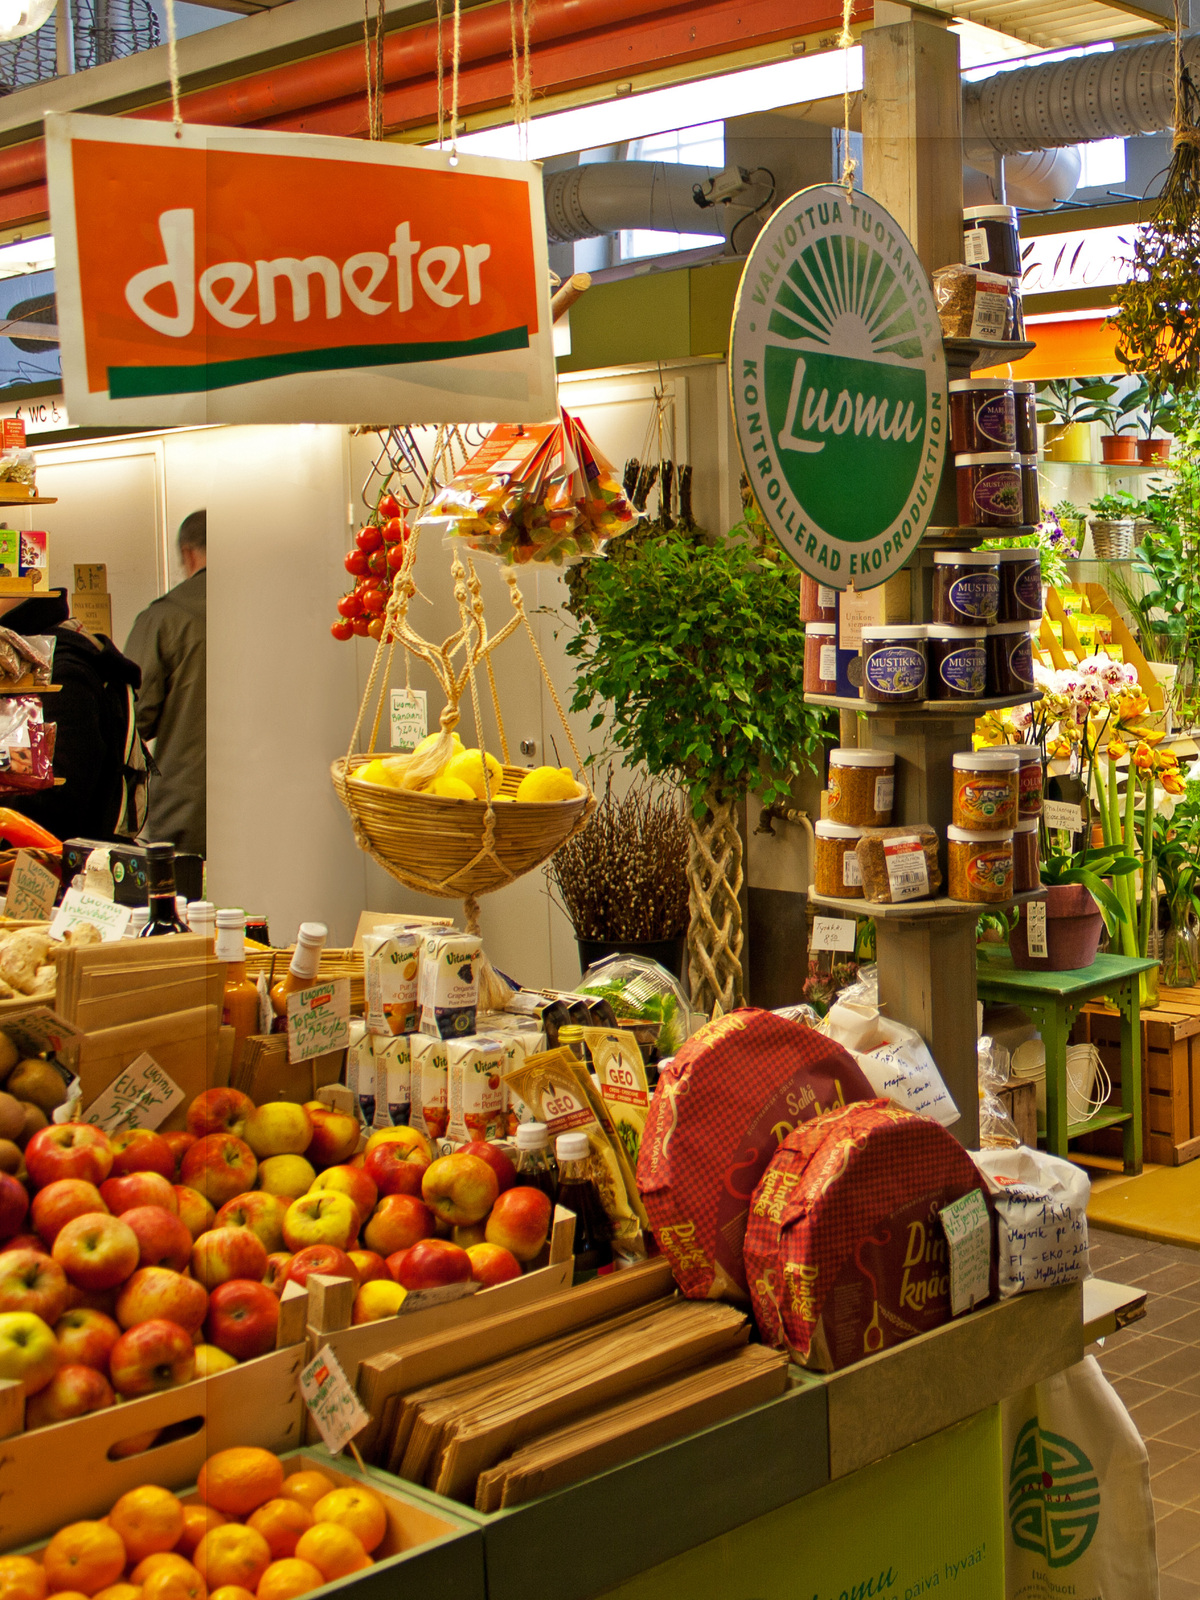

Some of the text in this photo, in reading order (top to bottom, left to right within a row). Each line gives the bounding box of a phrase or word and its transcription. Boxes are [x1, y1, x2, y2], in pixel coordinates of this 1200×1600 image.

[125, 207, 490, 338] demeter
[752, 201, 934, 338] VALVOTTUA TUOTANTOA
[29, 404, 47, 423] WC
[778, 357, 923, 453] Luomu
[743, 359, 942, 575] KONTROLLERAD EKOPRODUKTION
[958, 582, 999, 593] MUSTIKK
[871, 657, 922, 667] MUSTIKKA
[965, 786, 1010, 801] tyrni
[977, 859, 1013, 874] tyrn
[300, 984, 335, 1006] Luomu
[143, 1063, 174, 1100] Luomu
[609, 1068, 633, 1086] GEO
[547, 1096, 574, 1116] GEO
[786, 1084, 816, 1116] Saltå
[650, 1135, 663, 1174] KVARN
[902, 1220, 945, 1268] Din
[799, 1264, 819, 1323] Dinkel
[900, 1268, 949, 1312] knäc
[945, 1541, 987, 1581] hyvää!
